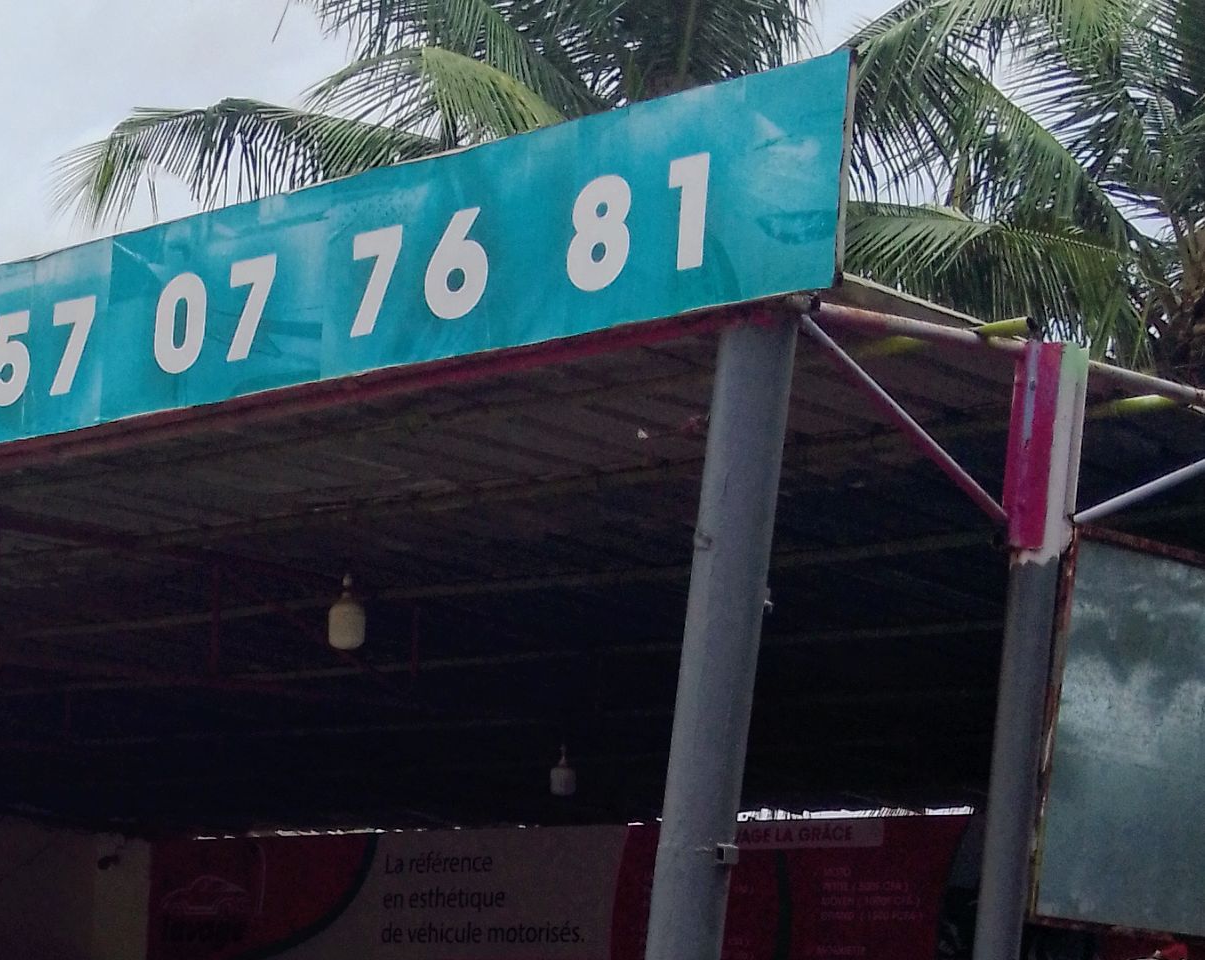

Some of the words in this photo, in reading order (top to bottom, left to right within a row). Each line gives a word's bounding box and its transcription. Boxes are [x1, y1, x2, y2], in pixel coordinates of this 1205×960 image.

[154, 255, 277, 374] 07
[350, 207, 488, 337] 76
[566, 153, 710, 291] 81
[775, 827, 793, 842] LA
[385, 854, 404, 874] La
[409, 851, 493, 873] référence
[383, 894, 403, 909] en
[409, 887, 505, 912] esthétique
[381, 922, 402, 943] de
[487, 920, 585, 943] motorisés.
